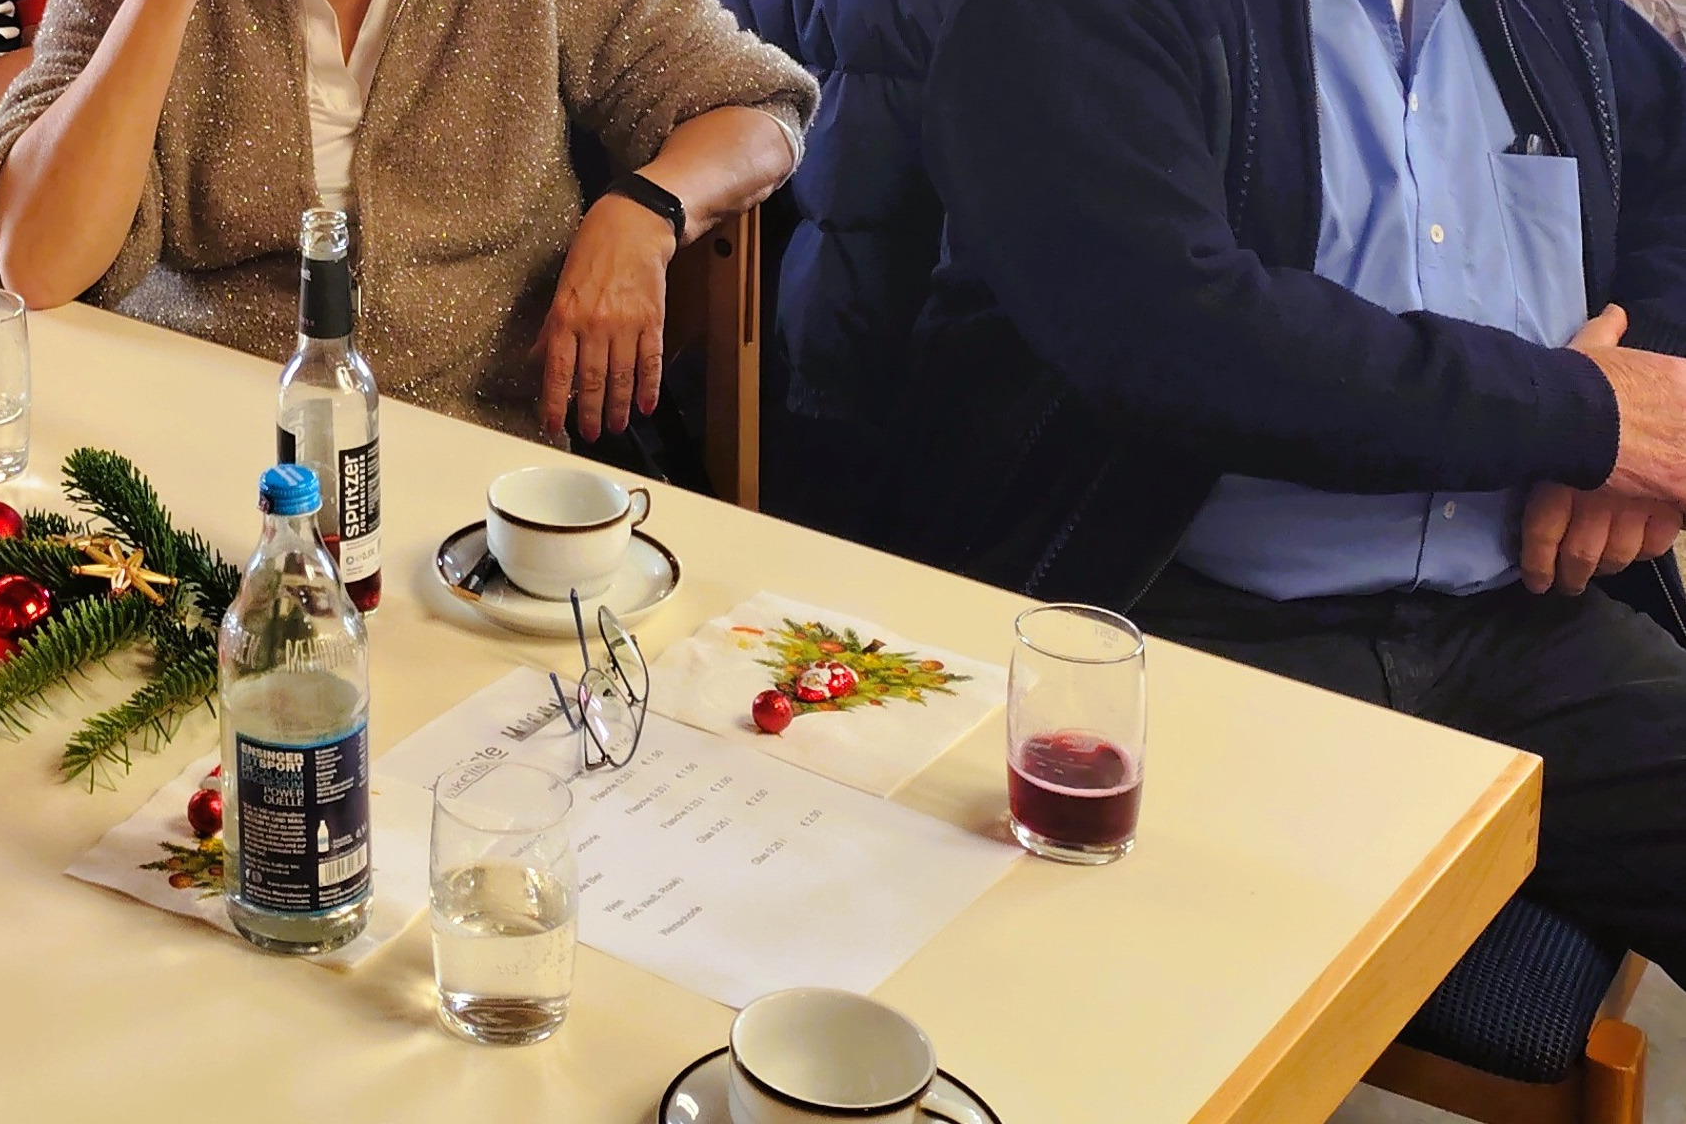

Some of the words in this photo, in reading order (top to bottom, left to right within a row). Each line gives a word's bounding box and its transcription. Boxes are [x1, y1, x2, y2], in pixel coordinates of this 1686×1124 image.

[241, 742, 304, 764] ENSINGER
[258, 758, 304, 773] SPORT
[264, 787, 304, 799] POWER
[264, 795, 304, 807] QUELLE
